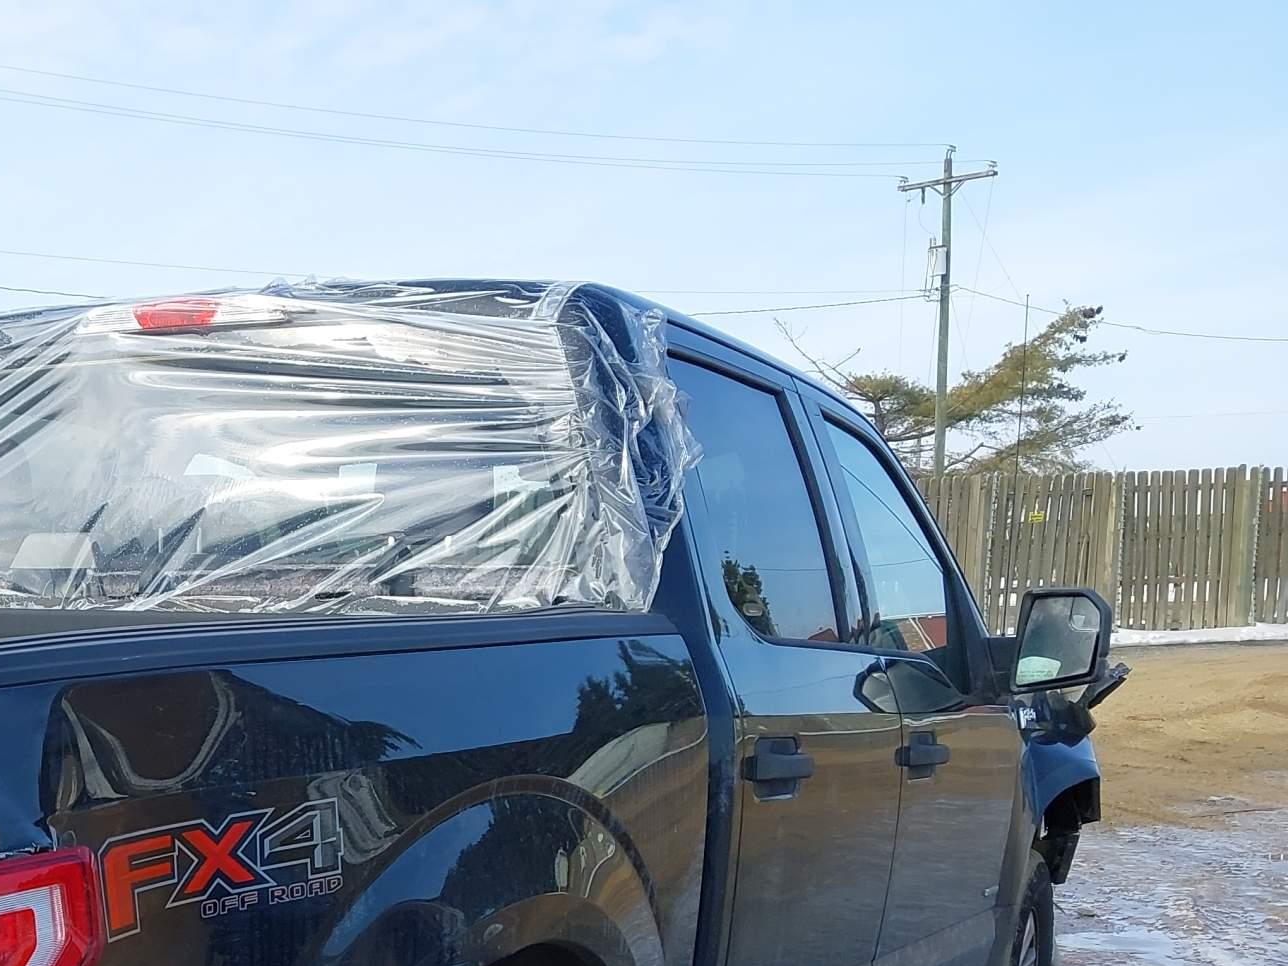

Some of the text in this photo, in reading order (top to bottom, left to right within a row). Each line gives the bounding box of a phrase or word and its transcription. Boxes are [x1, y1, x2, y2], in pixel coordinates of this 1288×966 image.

[98, 798, 345, 943] FX4
[200, 875, 344, 919] OFF ROAD
